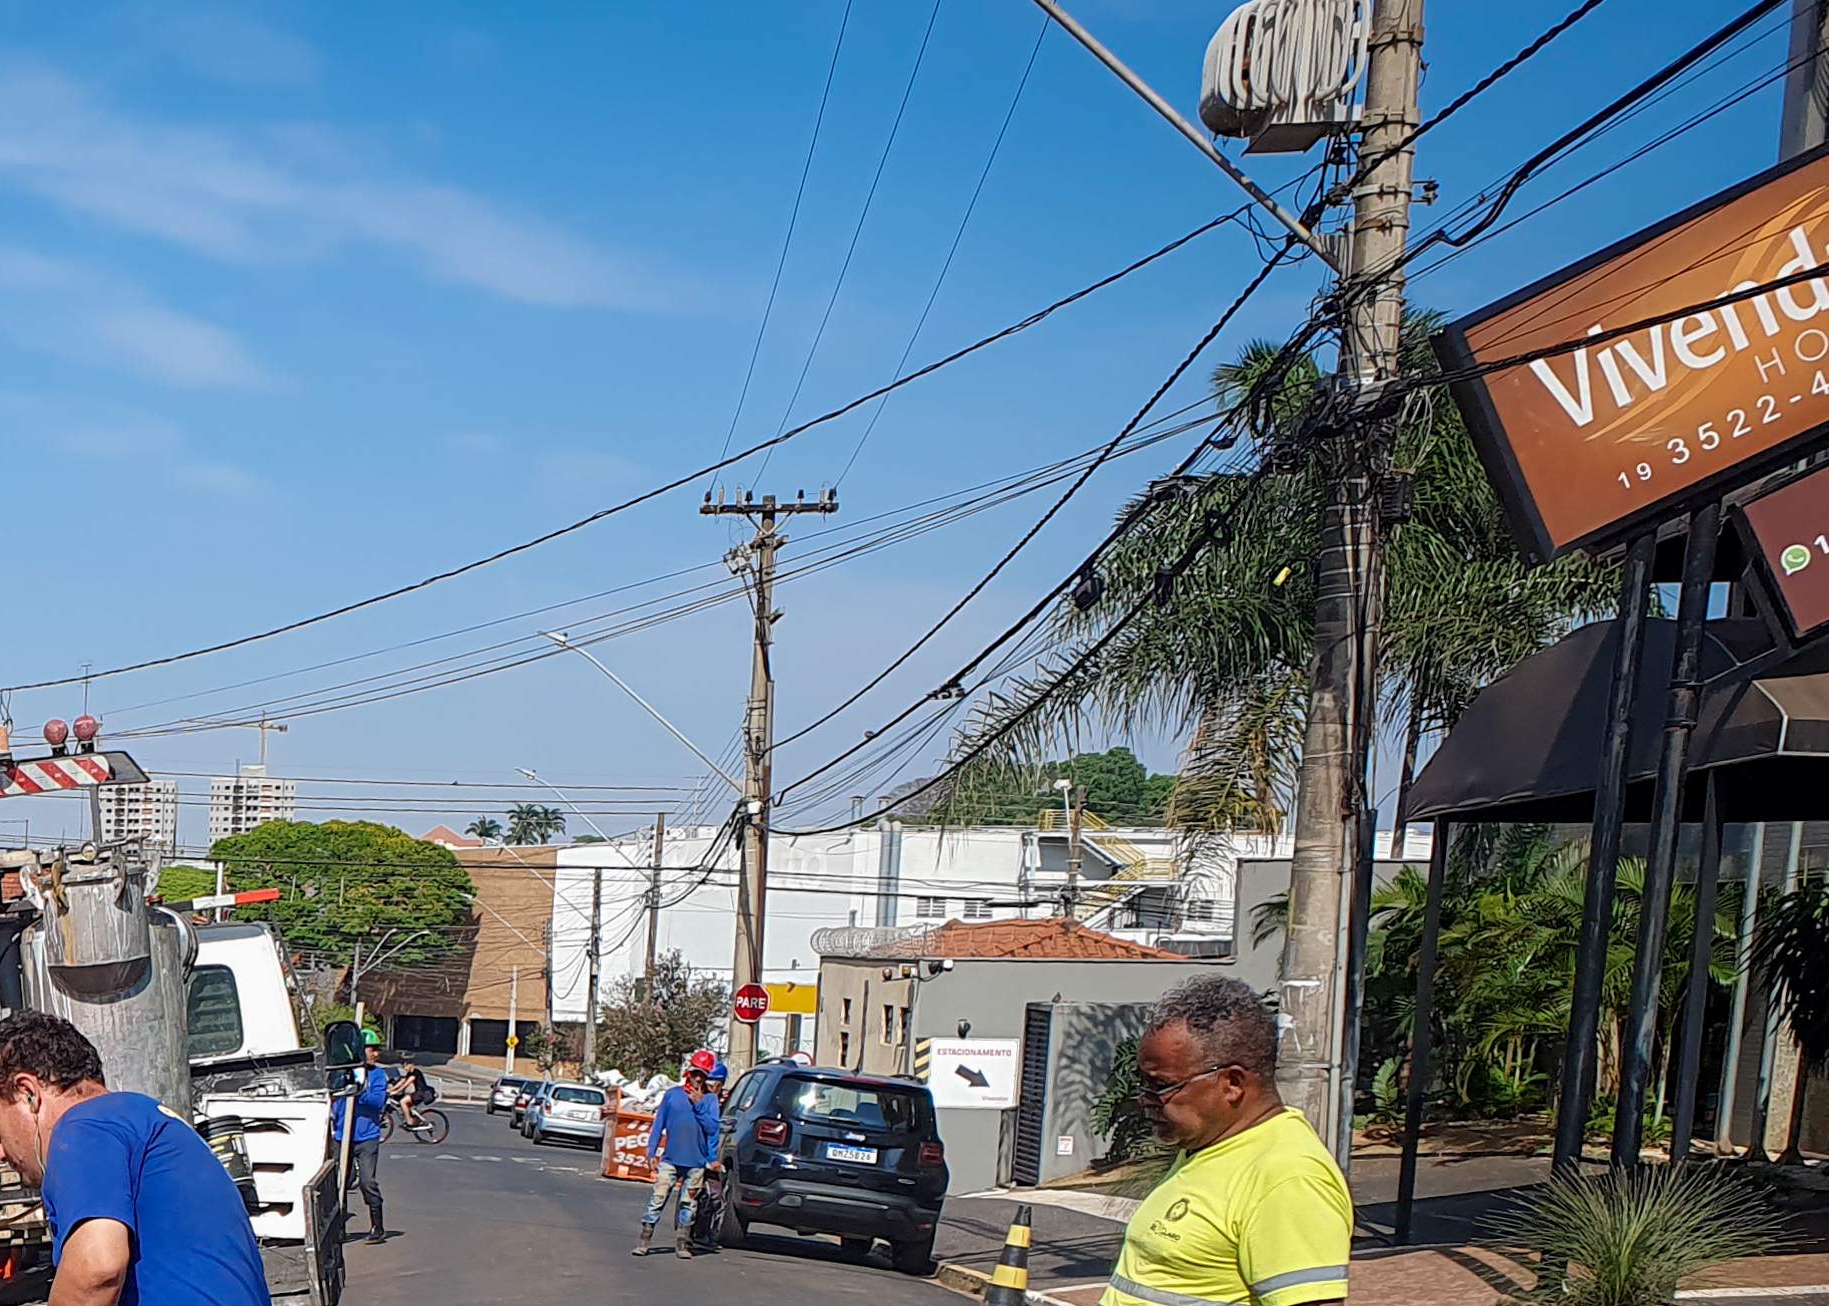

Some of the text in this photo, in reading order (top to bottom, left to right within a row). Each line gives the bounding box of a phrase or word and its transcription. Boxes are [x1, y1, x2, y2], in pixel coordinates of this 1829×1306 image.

[1529, 225, 1829, 427] Vivend
[1617, 463, 1652, 490] 19
[736, 996, 767, 1009] PARE
[937, 1048, 1012, 1057] ESTACIONAMENTO
[614, 1132, 650, 1151] PEG
